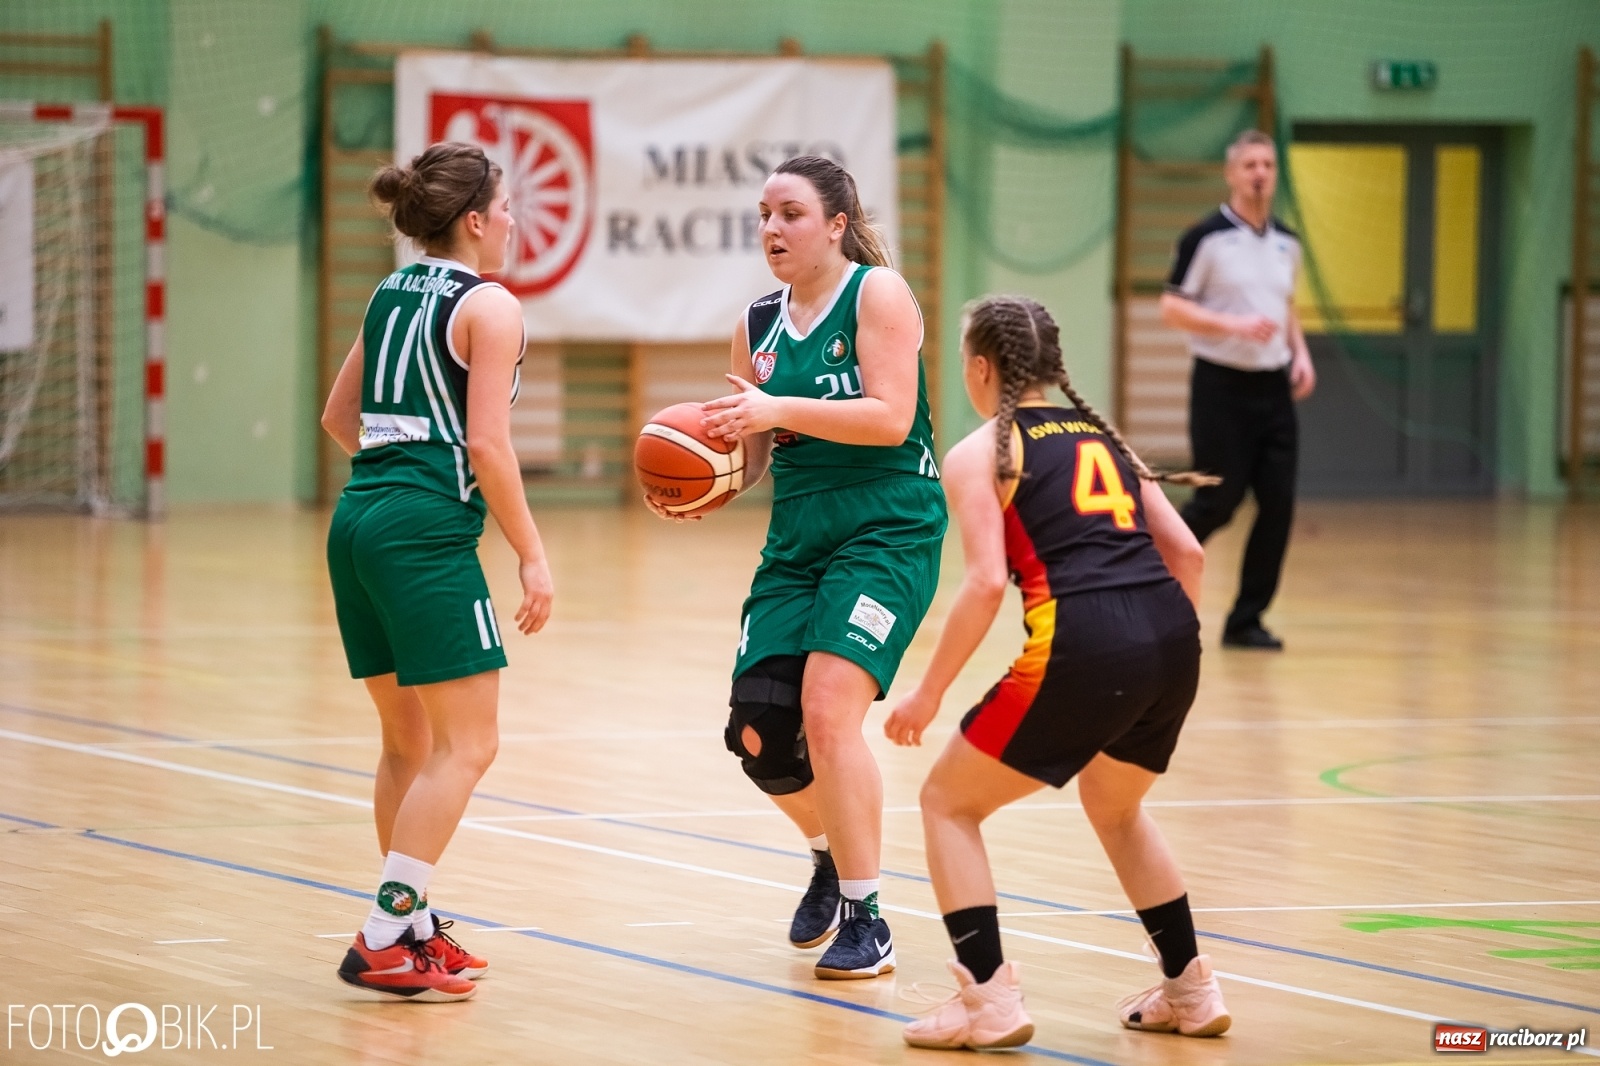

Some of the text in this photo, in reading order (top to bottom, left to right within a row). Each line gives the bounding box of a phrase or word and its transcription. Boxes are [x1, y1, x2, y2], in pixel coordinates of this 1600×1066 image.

[374, 306, 423, 404] 11
[815, 364, 866, 400] 24
[1072, 439, 1137, 531] 4
[473, 597, 501, 650] 11
[846, 631, 877, 652] COLO
